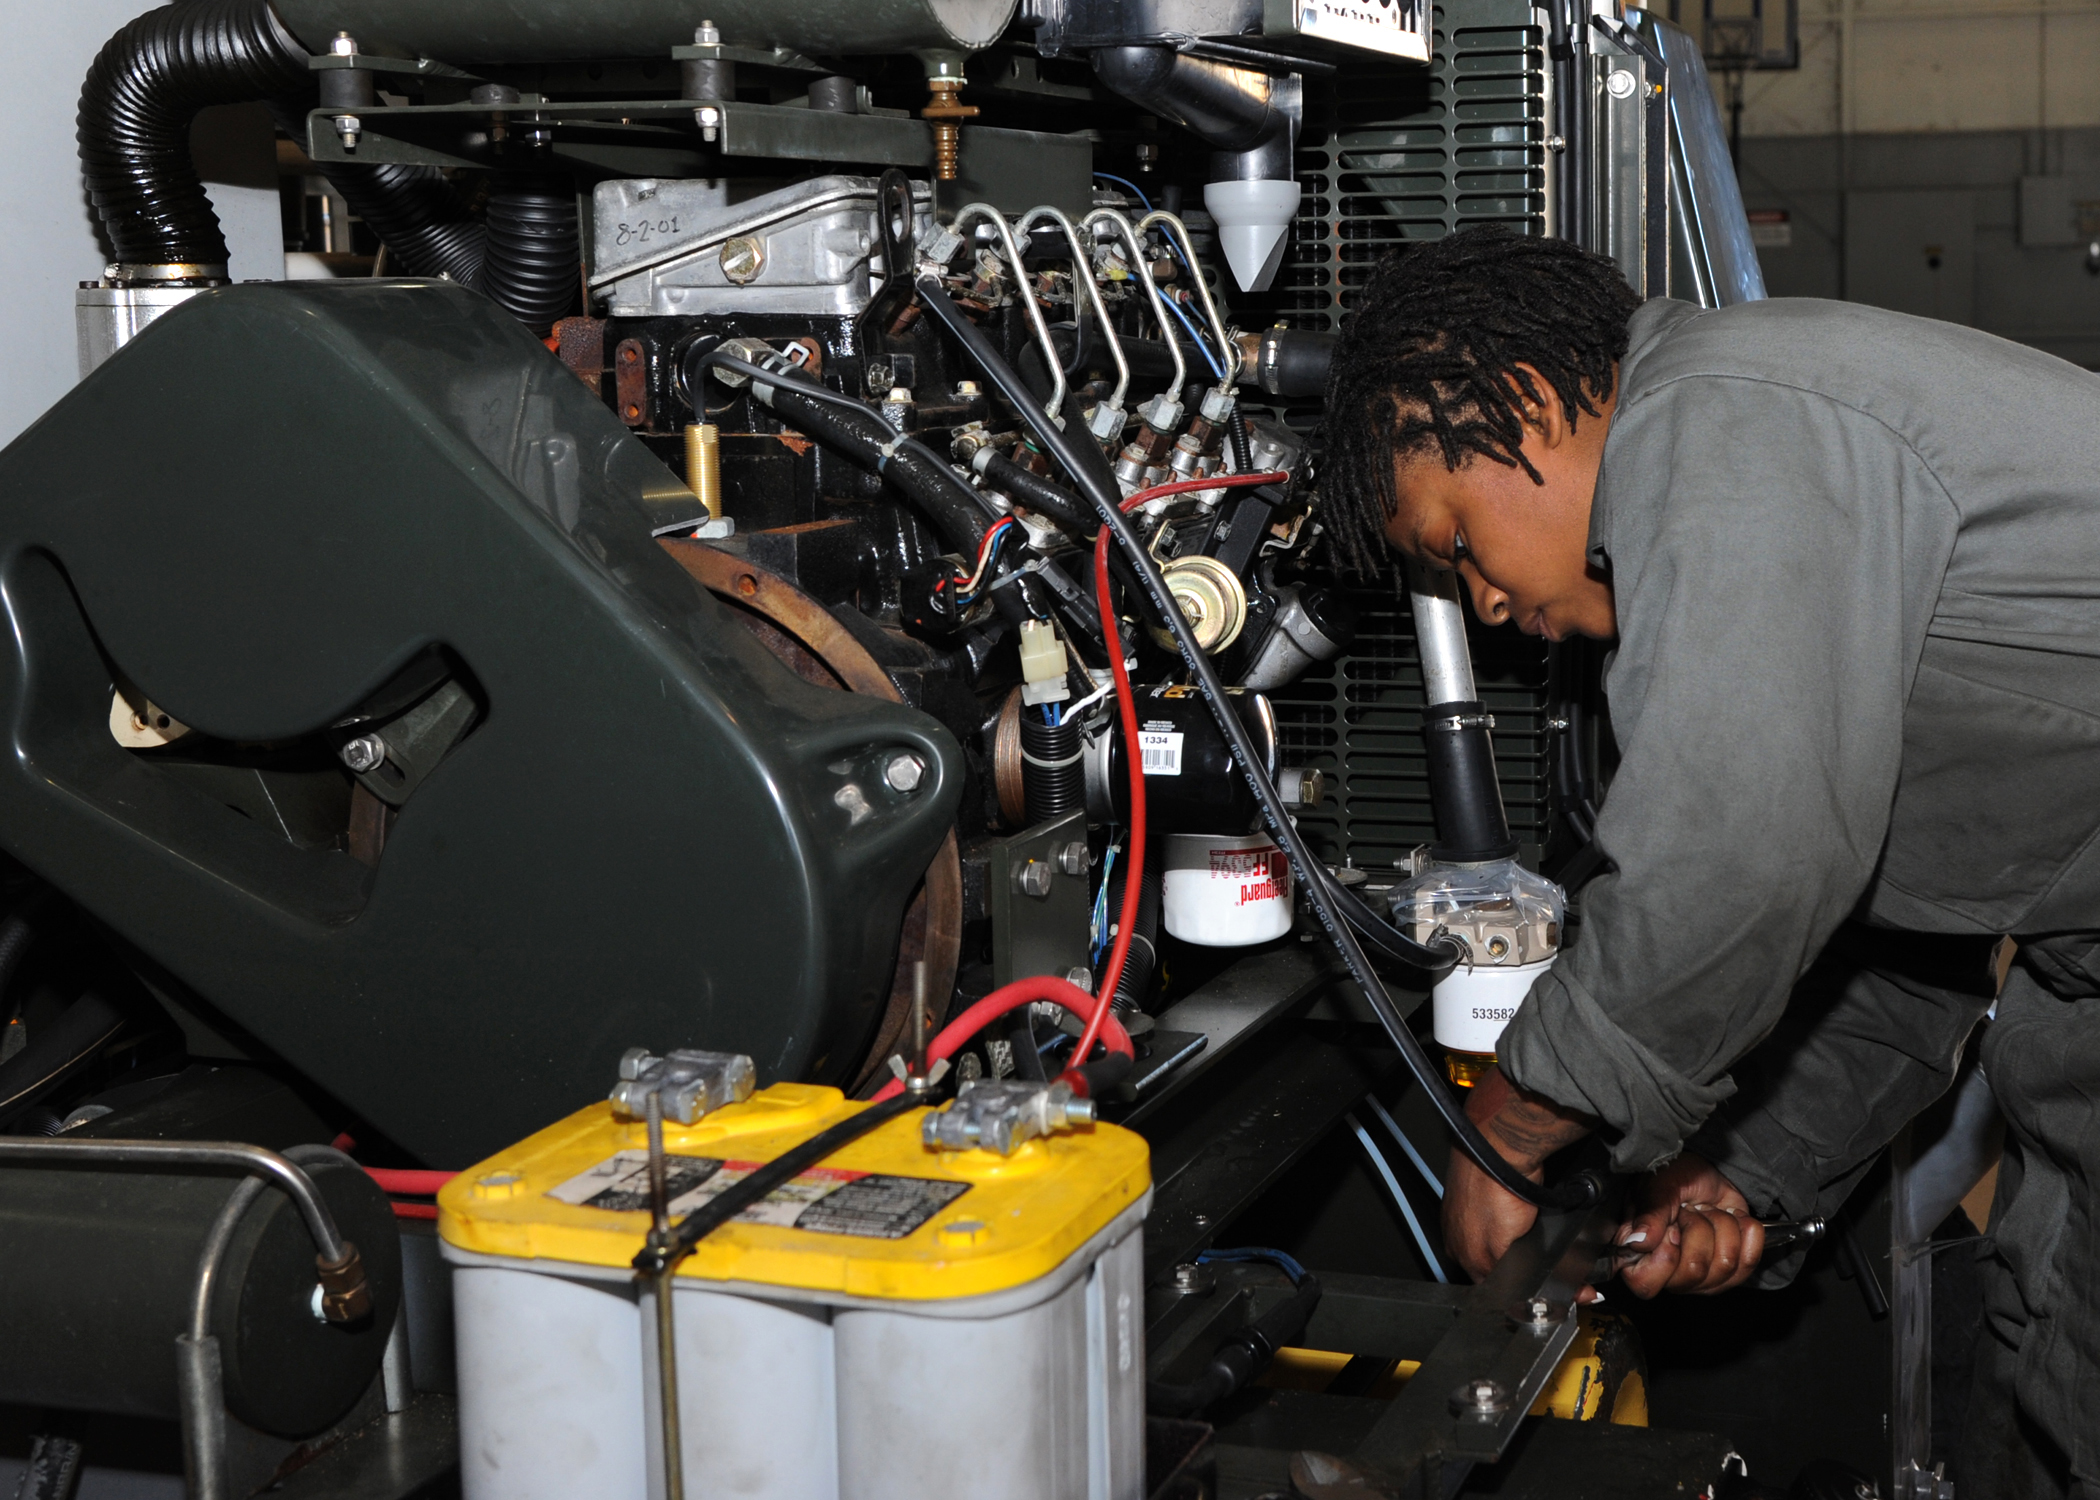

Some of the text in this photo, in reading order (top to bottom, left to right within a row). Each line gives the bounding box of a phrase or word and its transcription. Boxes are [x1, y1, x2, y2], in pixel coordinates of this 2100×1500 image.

[616, 216, 680, 246] 8-2-01
[1144, 736, 1168, 744] 1334
[1241, 876, 1288, 906] Fleetguard
[1472, 1008, 1515, 1020] 533582
